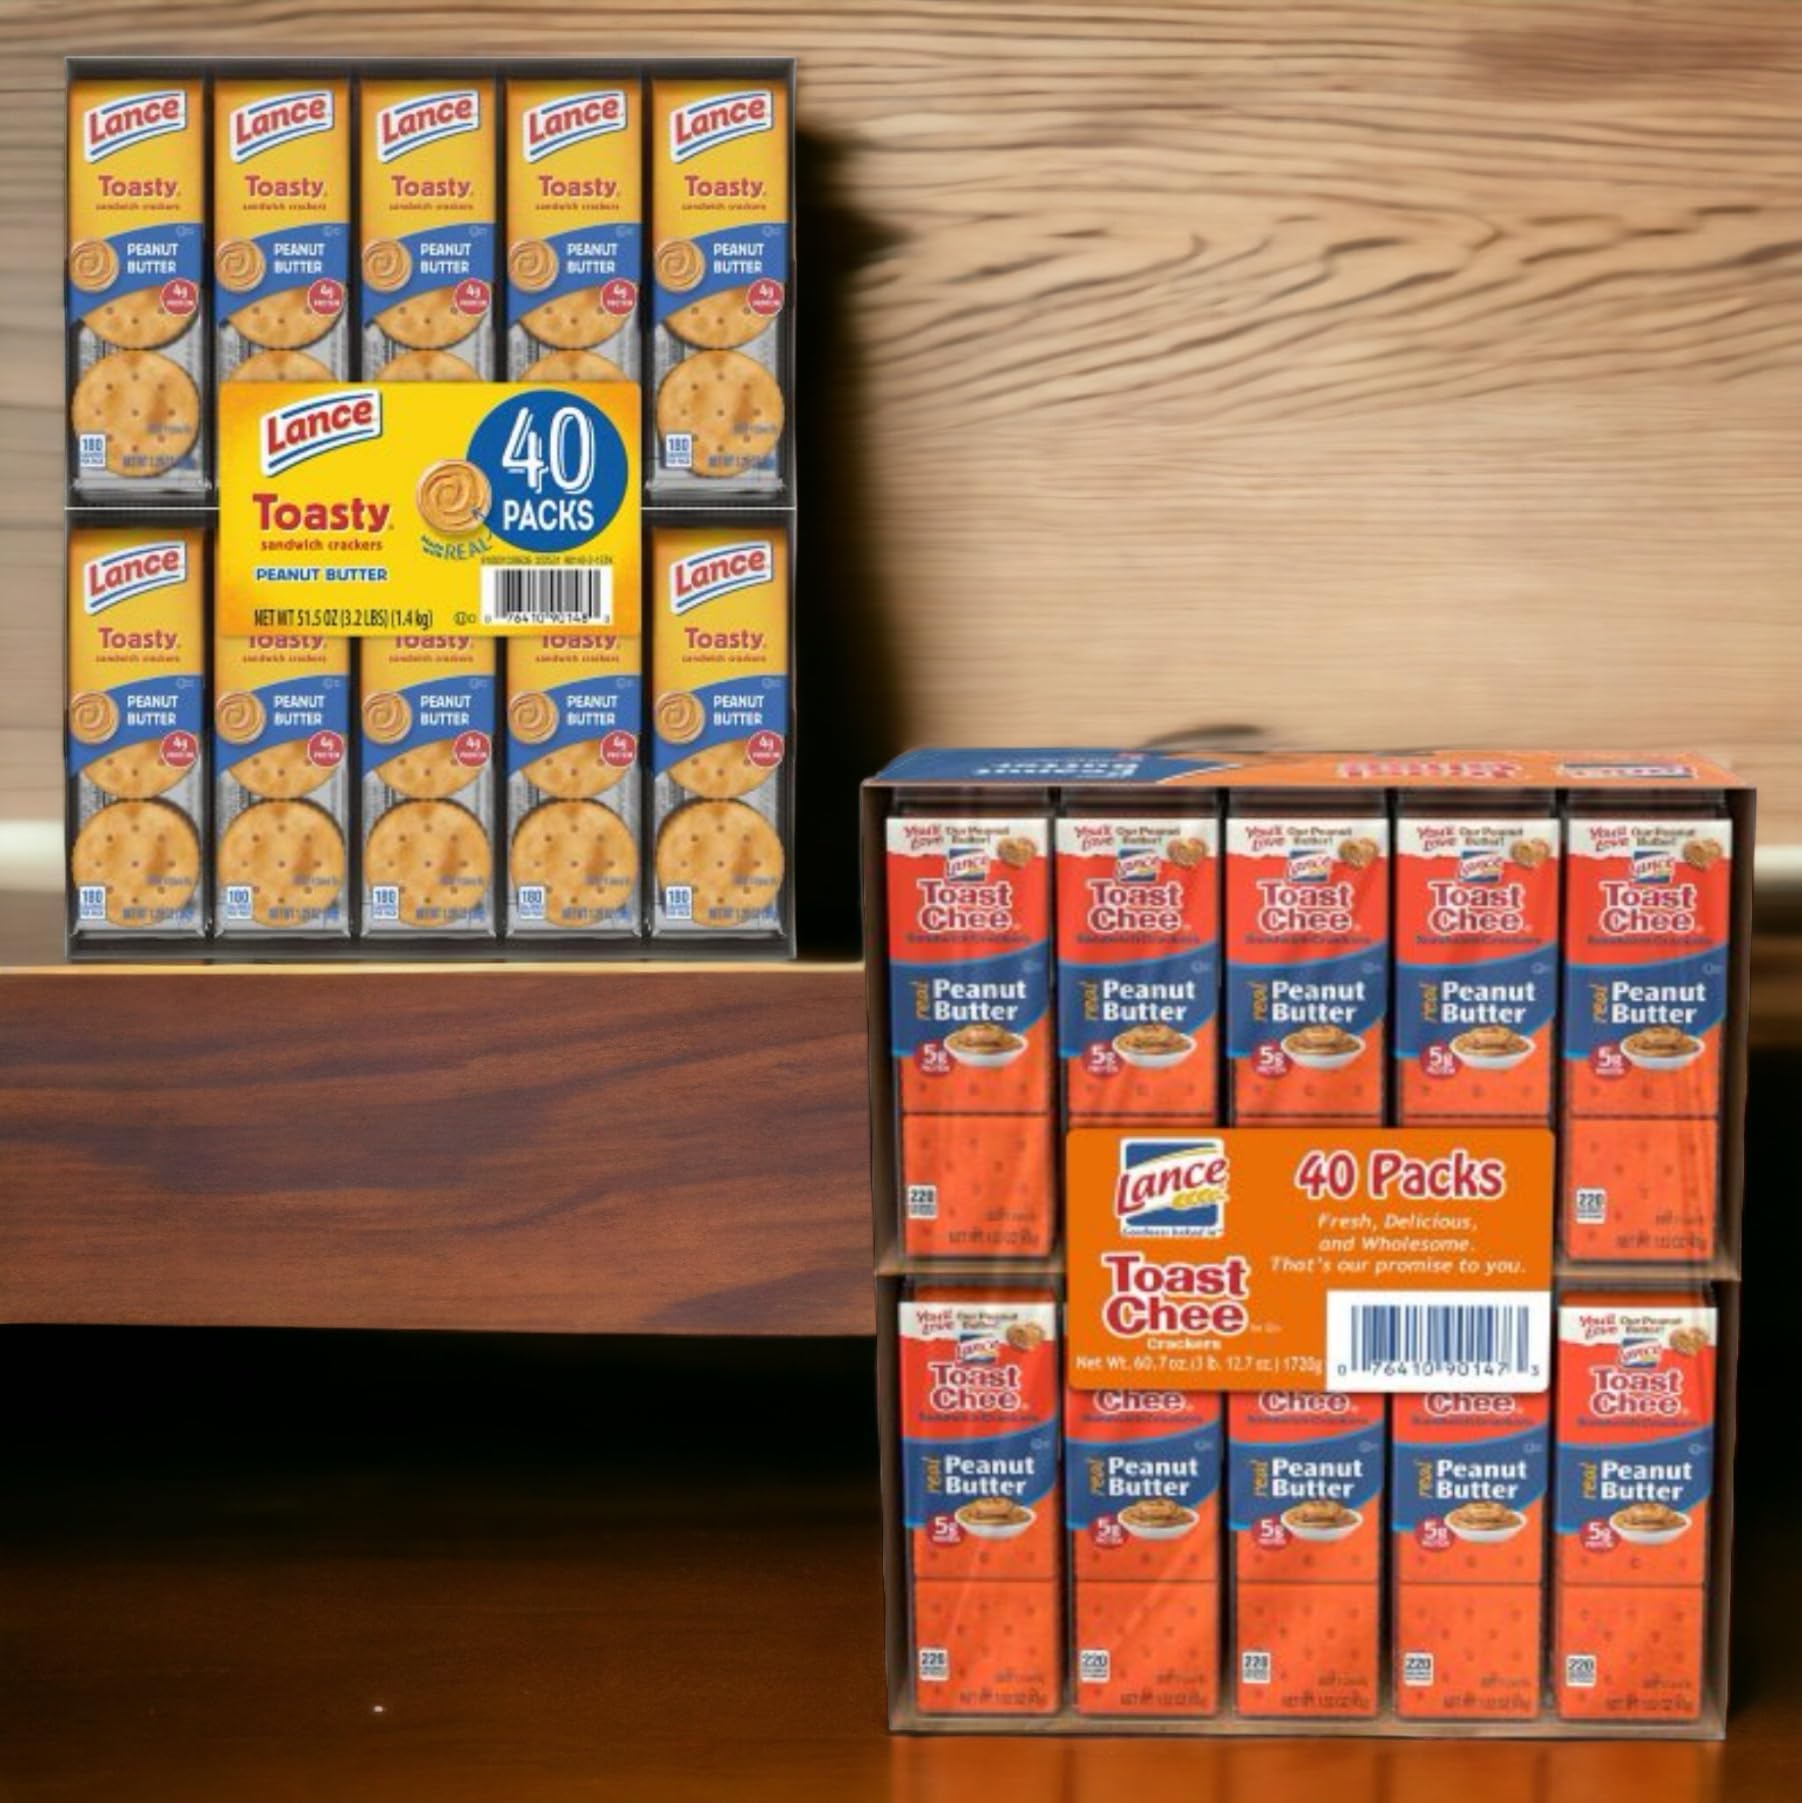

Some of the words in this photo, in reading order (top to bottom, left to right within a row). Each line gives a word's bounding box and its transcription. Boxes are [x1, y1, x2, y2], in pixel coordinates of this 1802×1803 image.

[88, 98, 180, 145] Lance
[235, 98, 327, 145] Lance
[381, 98, 473, 145] Lance
[528, 98, 620, 145] Lance
[674, 98, 766, 145] Lance
[127, 243, 178, 256] PEANUT
[274, 243, 325, 256] PEANUT
[420, 243, 471, 256] PEANUT
[567, 243, 618, 256] PEANUT
[713, 243, 764, 256] PEANUT
[127, 261, 177, 274] BUTTER
[274, 261, 324, 274] BUTTER
[420, 261, 470, 274] BUTTER
[567, 261, 617, 274] BUTTER
[713, 261, 763, 274] BUTTER
[267, 399, 373, 456] Lance
[502, 406, 596, 494] 40
[252, 493, 390, 532] Toasty
[503, 500, 594, 531] PACKS
[261, 539, 323, 551] sandwich
[328, 539, 383, 551] crackers
[444, 539, 492, 560] REAL
[88, 550, 180, 597] Lance
[256, 568, 320, 581] PEANUT
[326, 568, 388, 581] BUTTER
[674, 550, 766, 597] Lance
[255, 609, 275, 626] NET
[297, 609, 322, 626] 51.5
[324, 609, 338, 626] OZ
[341, 609, 362, 628] (3.2
[365, 609, 388, 628] LBS)
[391, 609, 413, 628] (1.4
[415, 609, 433, 630] kg)
[127, 695, 178, 708] PEANUT
[274, 695, 325, 708] PEANUT
[420, 695, 471, 708] PEANUT
[567, 695, 618, 708] PEANUT
[713, 695, 764, 708] PEANUT
[127, 713, 177, 726] BUTTER
[274, 713, 324, 726] BUTTER
[420, 713, 470, 726] BUTTER
[567, 713, 617, 726] BUTTER
[713, 713, 763, 726] BUTTER
[919, 881, 1011, 907] Toast
[1089, 881, 1181, 907] Toast
[1259, 883, 1351, 908] Toast
[1430, 883, 1522, 908] Toast
[1602, 884, 1695, 908] Toast
[921, 908, 1011, 931] Chee
[1091, 908, 1180, 931] Chee
[1260, 909, 1350, 932] Chee
[1432, 909, 1521, 932] Chee
[1604, 909, 1693, 932] Chee
[934, 980, 1026, 999] Peanut
[1103, 981, 1195, 1000] Peanut
[1272, 980, 1366, 1000] Peanut
[1442, 981, 1536, 1001] Peanut
[1611, 982, 1705, 1002] Peanut
[934, 1001, 1018, 1021] Butter
[1103, 1002, 1187, 1021] Butter
[1272, 1003, 1356, 1022] Butter
[1442, 1003, 1526, 1023] Butter
[1611, 1004, 1697, 1024] Butter
[1297, 1153, 1356, 1198] 40
[1370, 1152, 1503, 1198] Packs
[1116, 1157, 1227, 1216] Lance
[1318, 1213, 1378, 1231] Fresh,
[1384, 1213, 1478, 1231] Delicious,
[1319, 1236, 1354, 1251] and
[1362, 1236, 1475, 1251] Wholesome.
[1105, 1255, 1247, 1296] Toast
[1270, 1257, 1330, 1272] That's
[1337, 1260, 1368, 1272] our
[1375, 1258, 1453, 1275] promise
[1459, 1258, 1480, 1272] to
[1485, 1261, 1526, 1275] you.
[1106, 1296, 1244, 1335] Chee
[1147, 1338, 1222, 1350] Crackers
[1076, 1356, 1103, 1370] Net
[1371, 1363, 1435, 1376] 76410
[931, 1365, 1018, 1387] Toast
[1592, 1369, 1682, 1392] Toast
[932, 1388, 1018, 1410] Chee
[1592, 1393, 1679, 1415] Chee
[945, 1456, 1035, 1474] Peanut
[1108, 1457, 1198, 1476] Peanut
[1272, 1457, 1362, 1477] Peanut
[1437, 1459, 1527, 1479] Peanut
[1601, 1461, 1692, 1480] Peanut
[945, 1477, 1026, 1495] Butter
[1108, 1478, 1190, 1497] Butter
[1272, 1479, 1355, 1498] Butter
[1437, 1480, 1519, 1499] Butter
[1601, 1482, 1683, 1501] Butter
